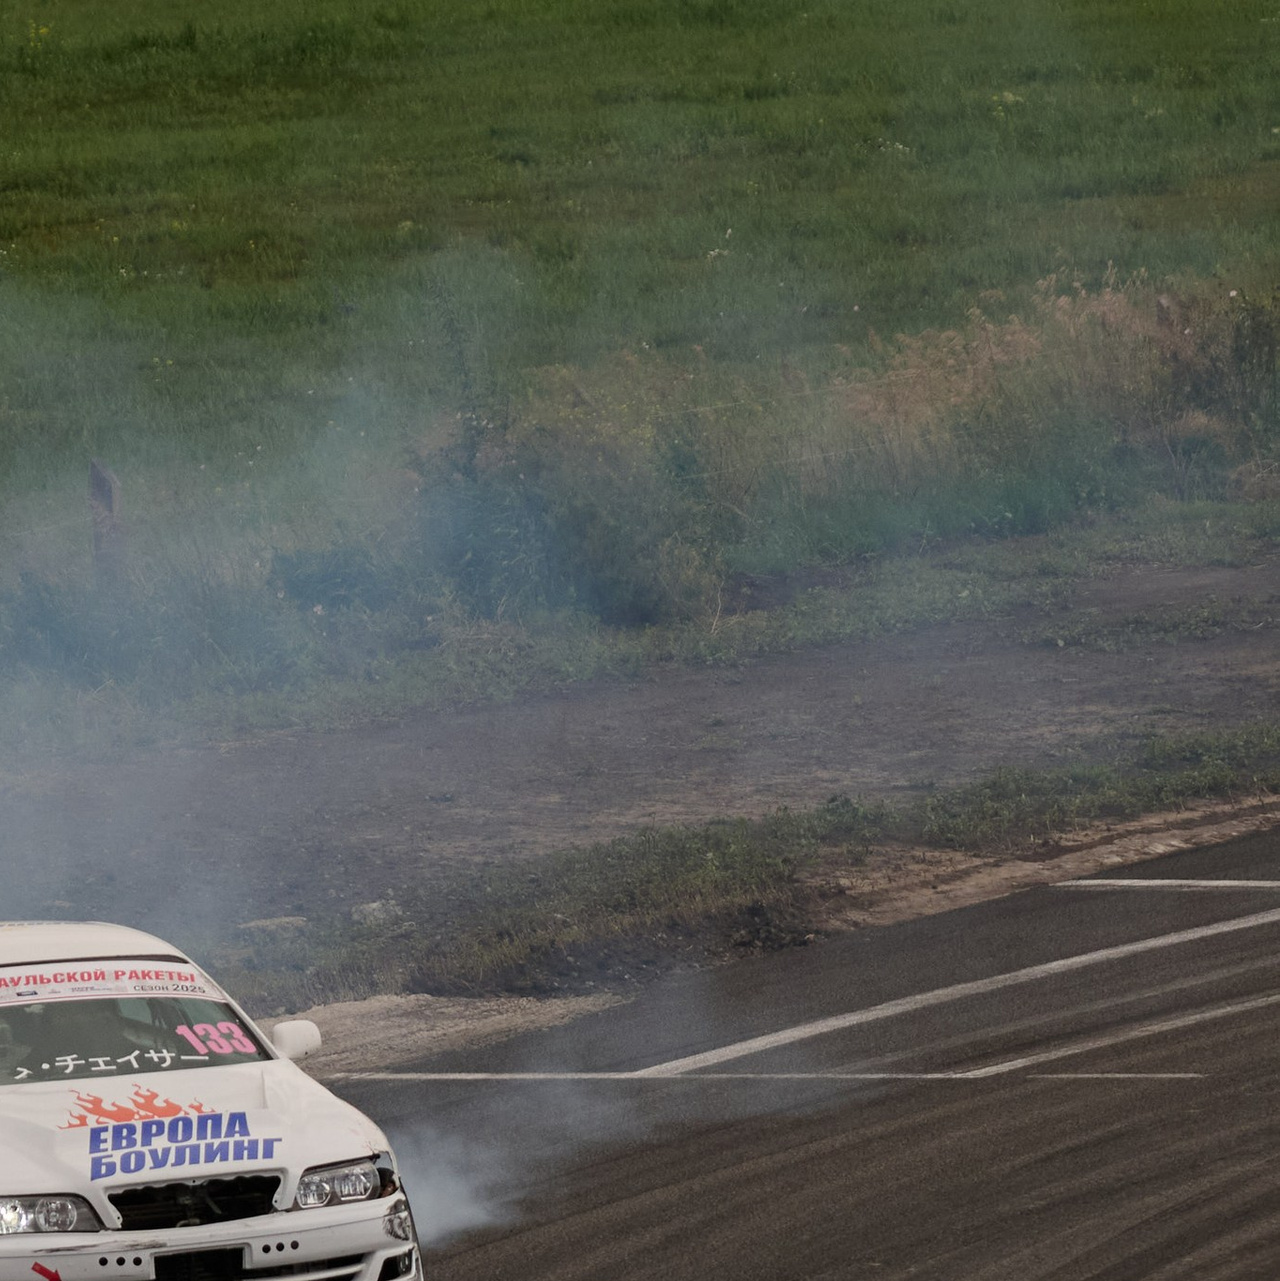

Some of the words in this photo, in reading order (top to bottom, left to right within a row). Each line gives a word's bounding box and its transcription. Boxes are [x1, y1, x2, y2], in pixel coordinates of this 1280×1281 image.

[114, 970, 196, 983] РАКЕТЫ
[172, 983, 207, 994] 2025
[175, 1021, 257, 1055] 133
[89, 1111, 251, 1154] ЕВРОПА
[90, 1138, 283, 1182] БОУЛИНГ
